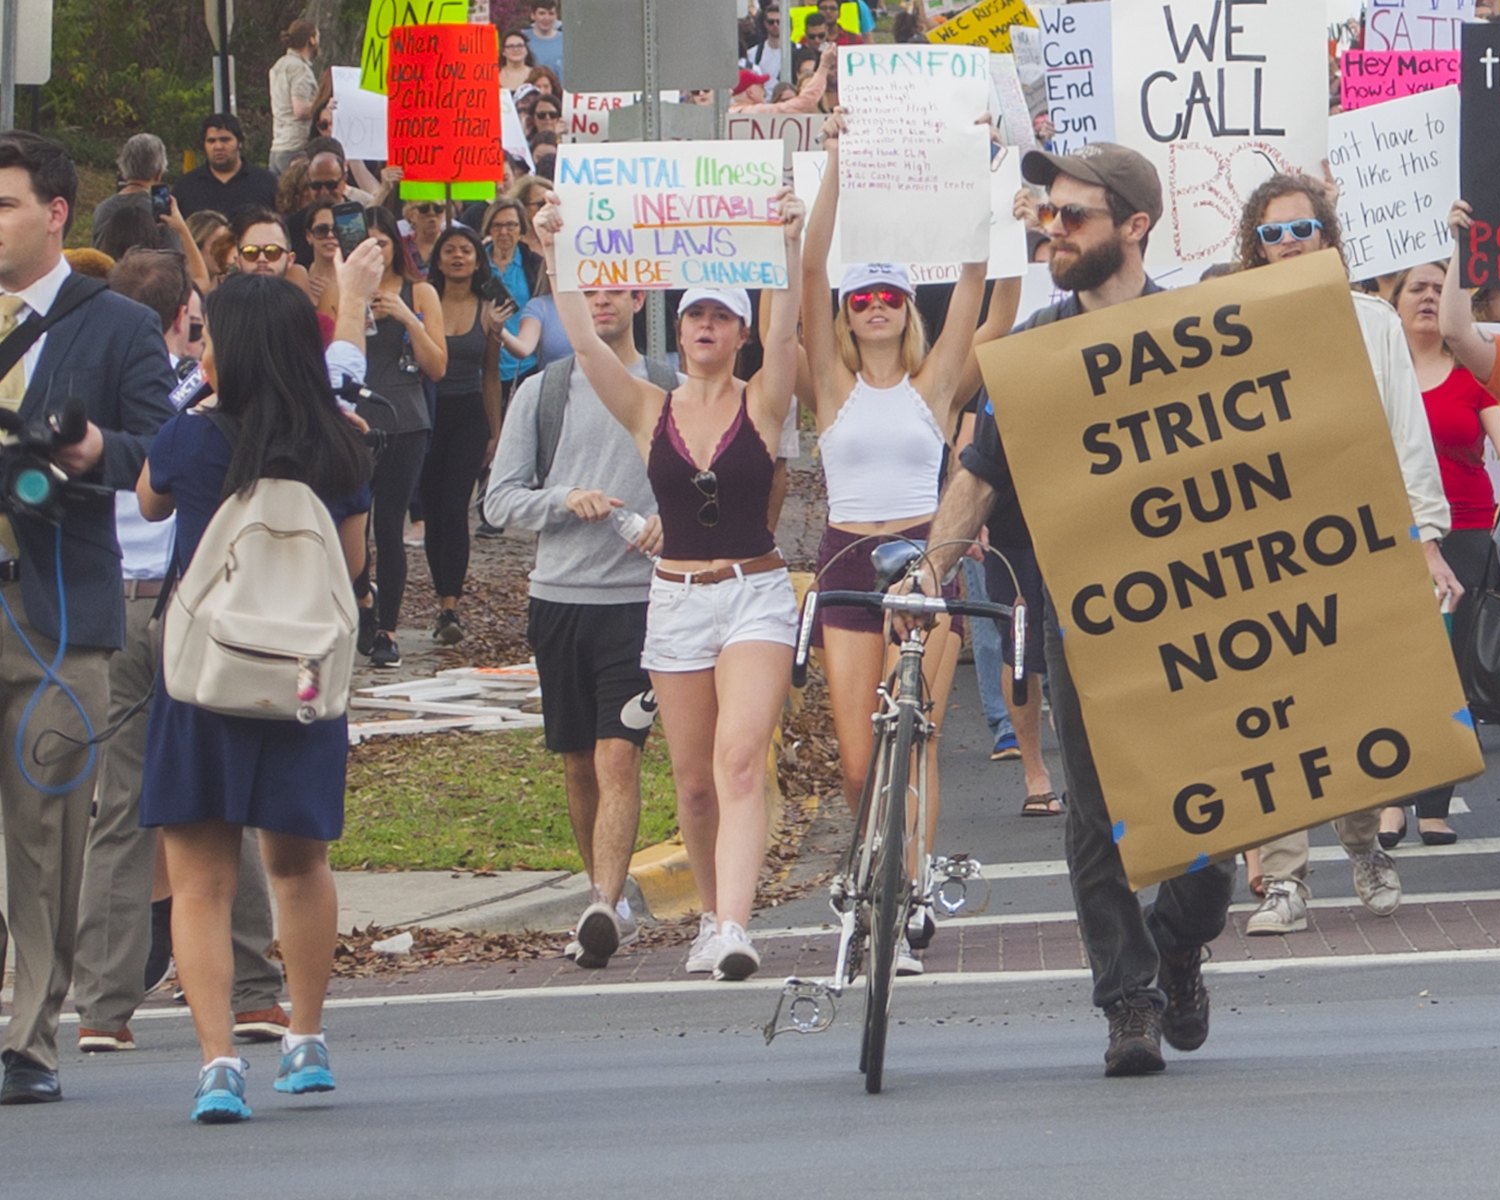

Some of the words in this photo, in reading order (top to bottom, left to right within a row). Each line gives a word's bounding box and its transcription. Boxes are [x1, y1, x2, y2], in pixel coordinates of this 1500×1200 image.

[936, 26, 958, 42] WE
[956, 17, 970, 31] C
[991, 8, 1030, 38] MONEY
[1039, 7, 1077, 35] We
[394, 29, 438, 56] When
[458, 26, 484, 55] will
[1042, 41, 1095, 69] Can
[389, 62, 425, 100] you
[435, 53, 468, 82] love
[473, 61, 500, 82] our
[846, 51, 924, 77] PRAY
[926, 51, 988, 80] FOR
[1344, 53, 1393, 82] Hey
[1397, 54, 1460, 76] Marc
[401, 80, 487, 110] children
[572, 93, 622, 111] FEAR
[1046, 71, 1095, 102] End
[1344, 77, 1397, 99] how'd
[1050, 106, 1098, 135] Gun
[1140, 67, 1286, 143] CALL
[393, 115, 440, 139] more
[452, 108, 491, 138] than
[1330, 130, 1363, 166] on't
[1371, 121, 1419, 153] have
[1425, 112, 1445, 141] to
[393, 144, 444, 173] your
[452, 137, 503, 180] guns?
[559, 157, 685, 189] MENTAL
[695, 154, 777, 188] Illness
[1355, 163, 1393, 190] like
[1400, 150, 1440, 177] this
[587, 191, 616, 221] is
[633, 193, 784, 225] INEVITABLE
[1359, 199, 1407, 228] have
[1413, 190, 1433, 214] to
[574, 225, 635, 257] GUN
[654, 227, 737, 258] LAWS
[1385, 227, 1427, 260] like
[576, 258, 629, 286] CAN
[634, 258, 672, 285] BE
[681, 258, 788, 287] CHANGED
[1081, 304, 1254, 397] PASS
[172, 368, 203, 402] WCTV
[1082, 369, 1293, 476] STRICT
[1130, 452, 1293, 539] GUN
[1071, 504, 1397, 637] CONTROL
[1158, 592, 1339, 693] NOW
[1235, 695, 1296, 739] or
